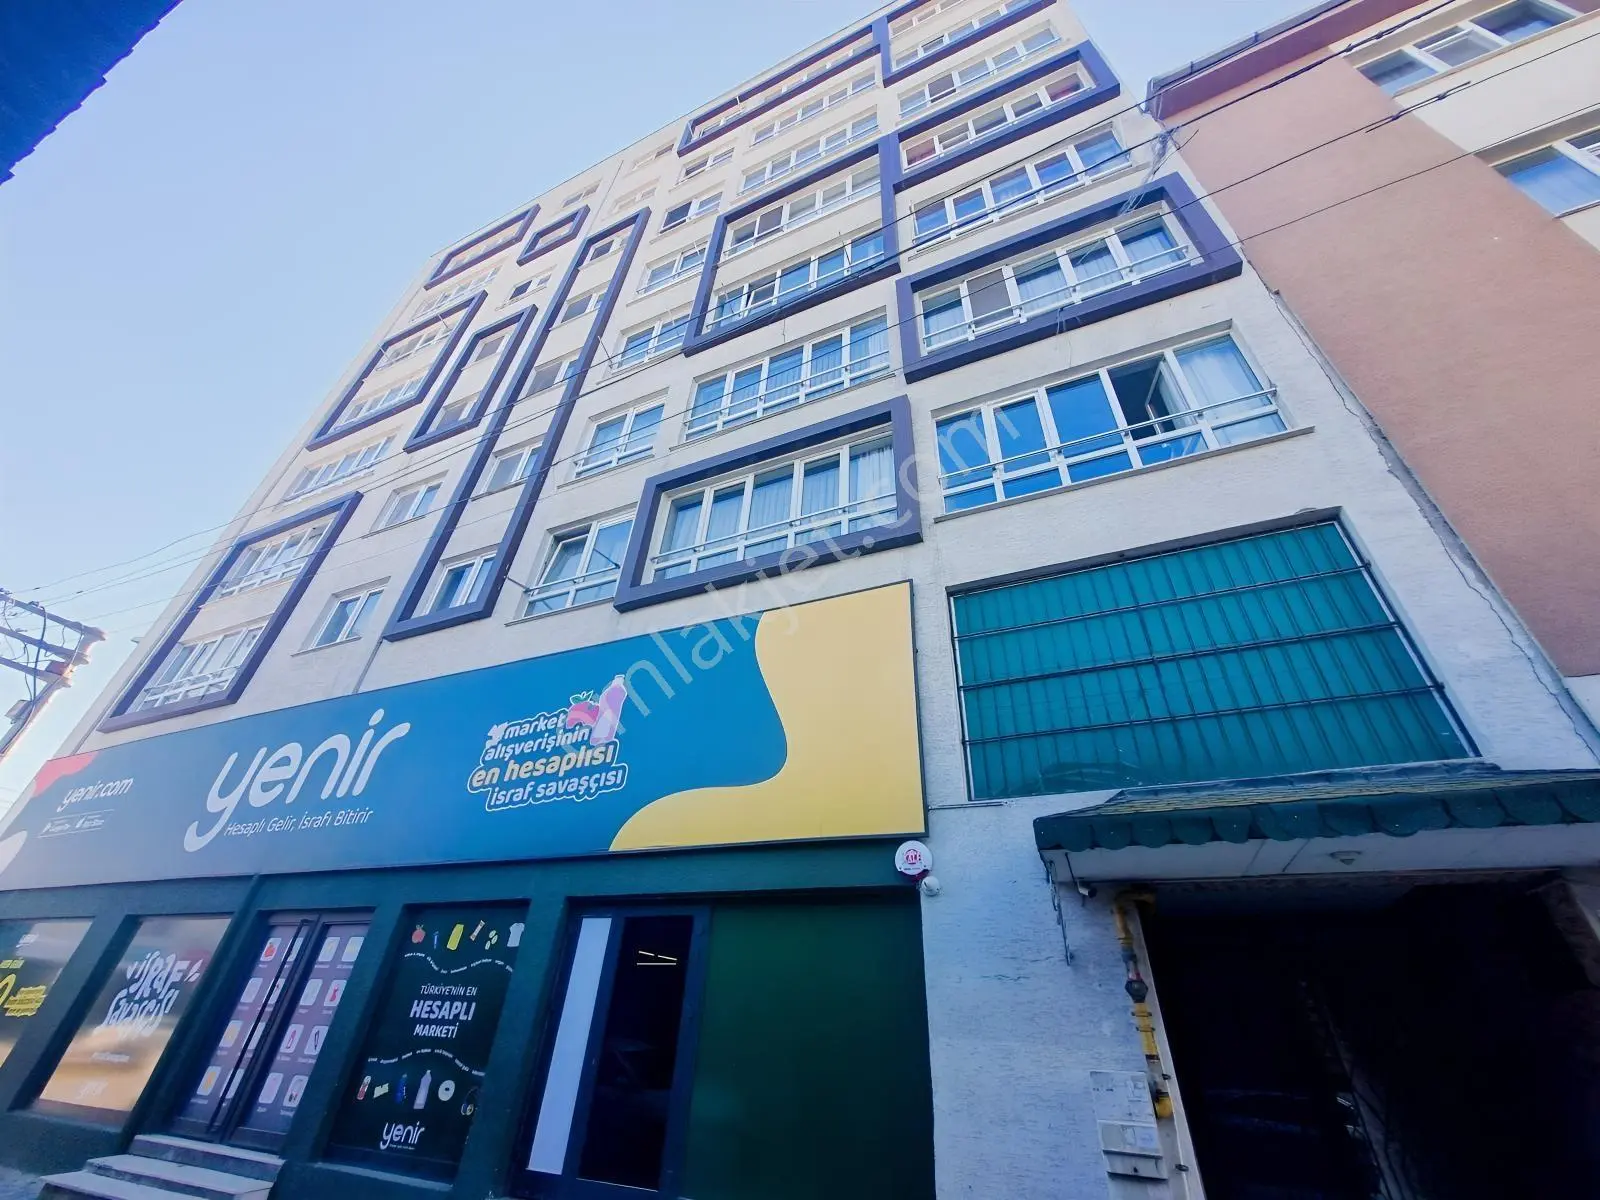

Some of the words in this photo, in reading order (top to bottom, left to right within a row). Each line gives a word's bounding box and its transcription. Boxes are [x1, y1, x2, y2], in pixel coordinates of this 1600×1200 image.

[504, 712, 567, 739] market
[484, 725, 590, 761] alışverişinin
[184, 708, 411, 852] yenir
[471, 767, 500, 787] en
[504, 745, 614, 782] hesaplısı
[56, 777, 134, 812] yenir.com
[490, 781, 535, 805] israf
[536, 770, 622, 795] savaşçısı
[224, 818, 265, 837] Hesaplı
[267, 815, 295, 832] Gelir,
[333, 807, 374, 826] Bitirir
[420, 983, 465, 995] TÜRKİYE'NİN
[466, 986, 477, 996] EN
[409, 1000, 476, 1020] HESAPLI
[413, 1022, 459, 1039] MARKETİ
[380, 1121, 425, 1149] yenir
